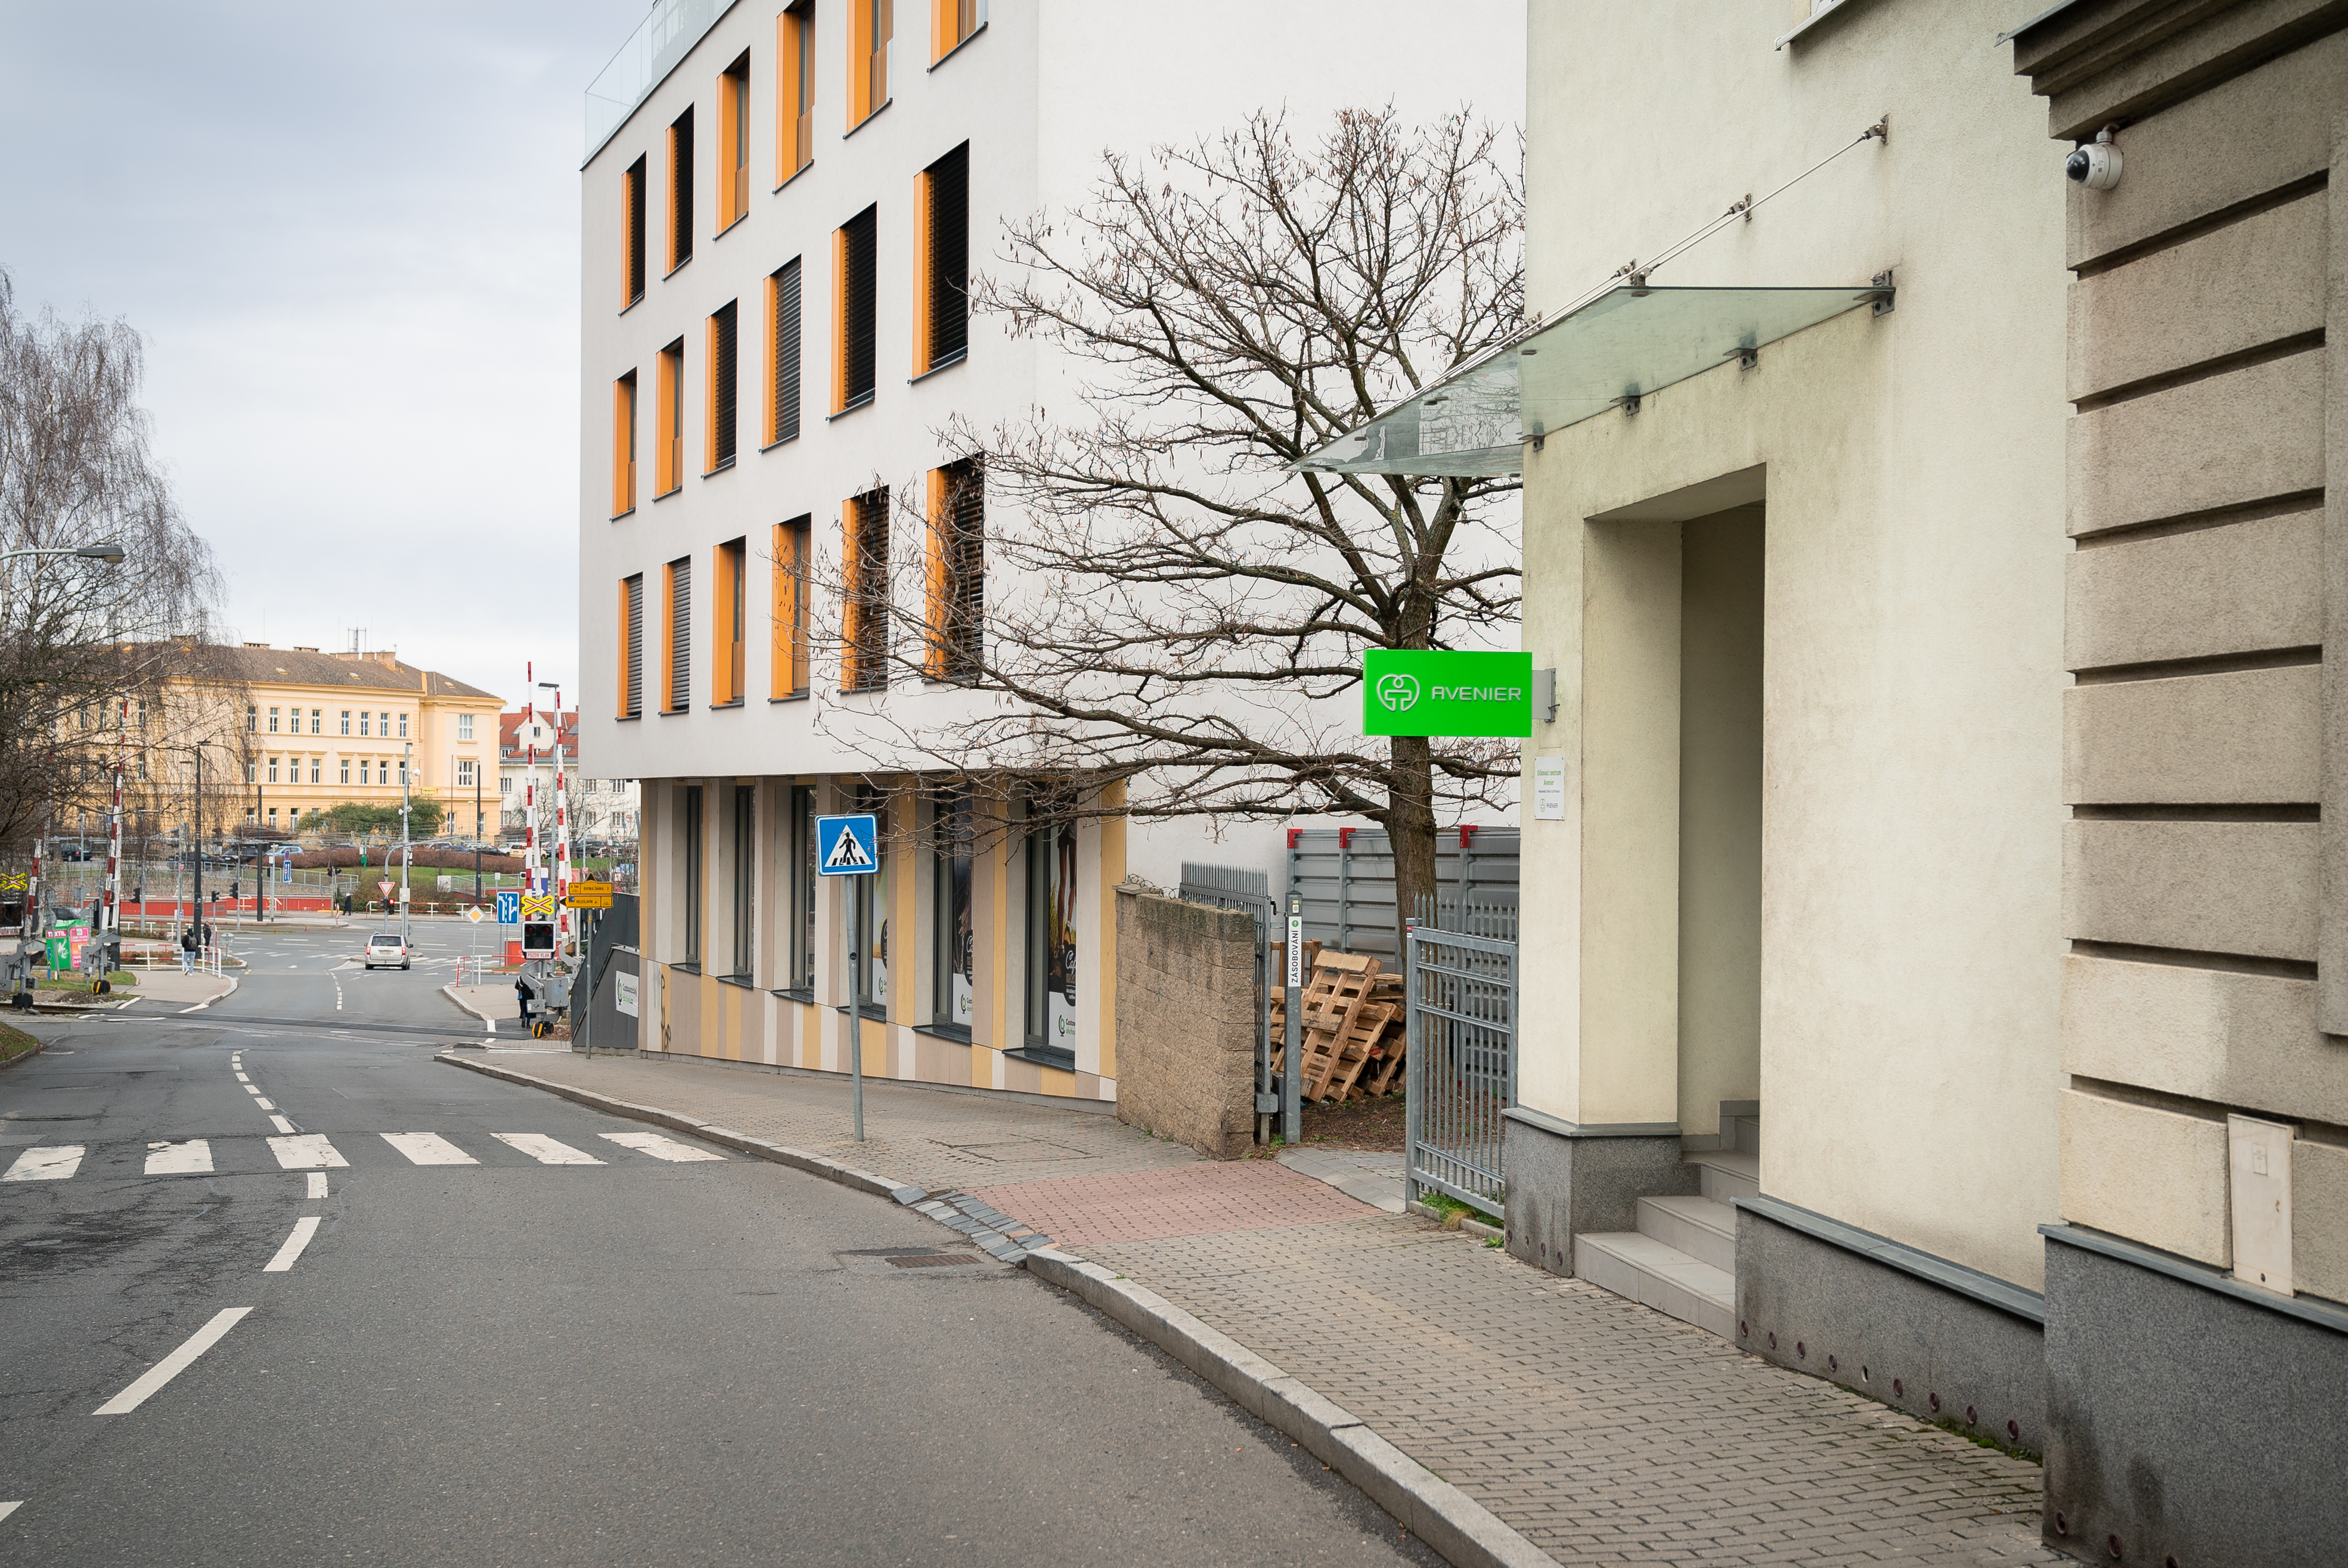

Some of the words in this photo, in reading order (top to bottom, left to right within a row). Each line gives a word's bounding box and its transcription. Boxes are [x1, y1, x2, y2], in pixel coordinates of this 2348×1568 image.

[1432, 686, 1521, 701] AVENIER
[1066, 950, 1076, 974] Caf
[1066, 1018, 1075, 1026] Cestov
